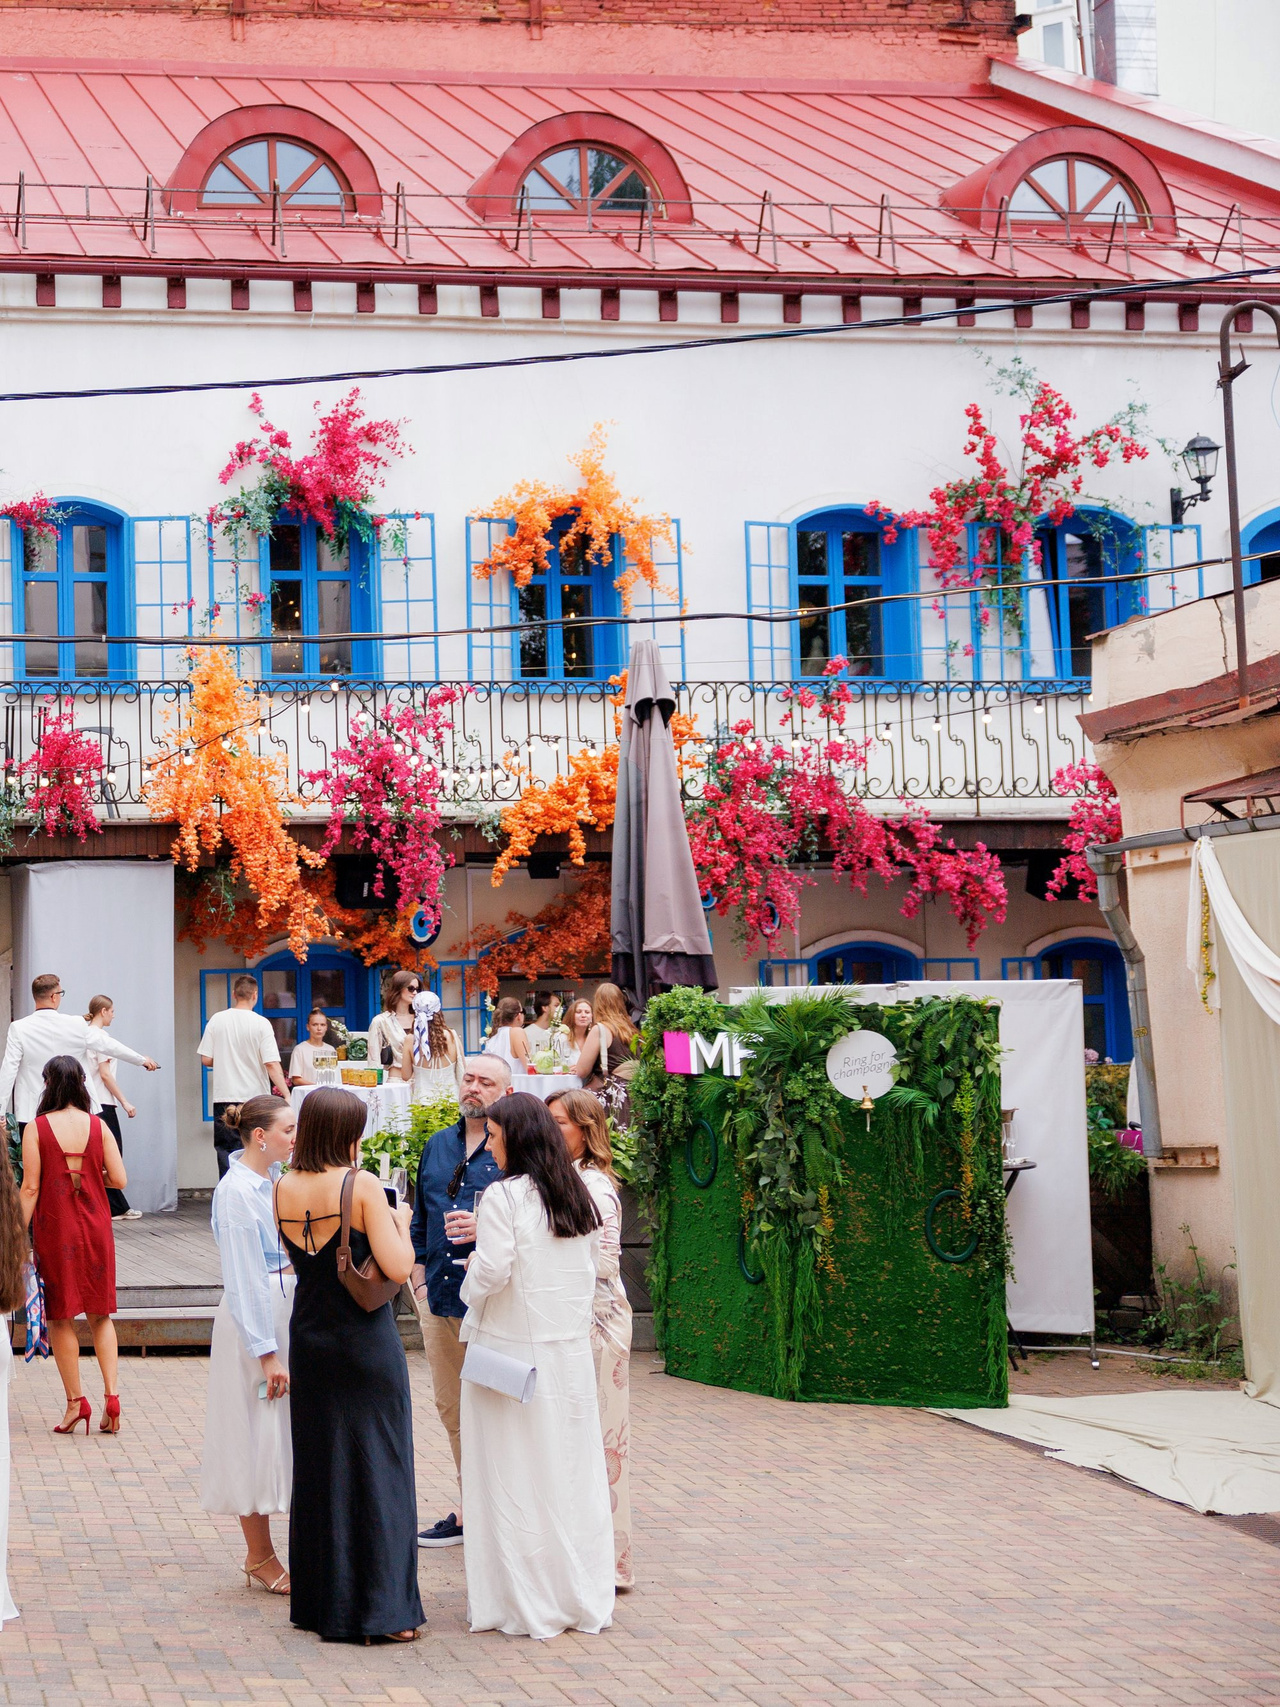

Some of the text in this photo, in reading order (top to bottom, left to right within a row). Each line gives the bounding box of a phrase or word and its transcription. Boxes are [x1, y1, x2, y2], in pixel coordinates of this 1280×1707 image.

[843, 1050, 886, 1068] Ring for
[833, 1059, 896, 1080] champagne
